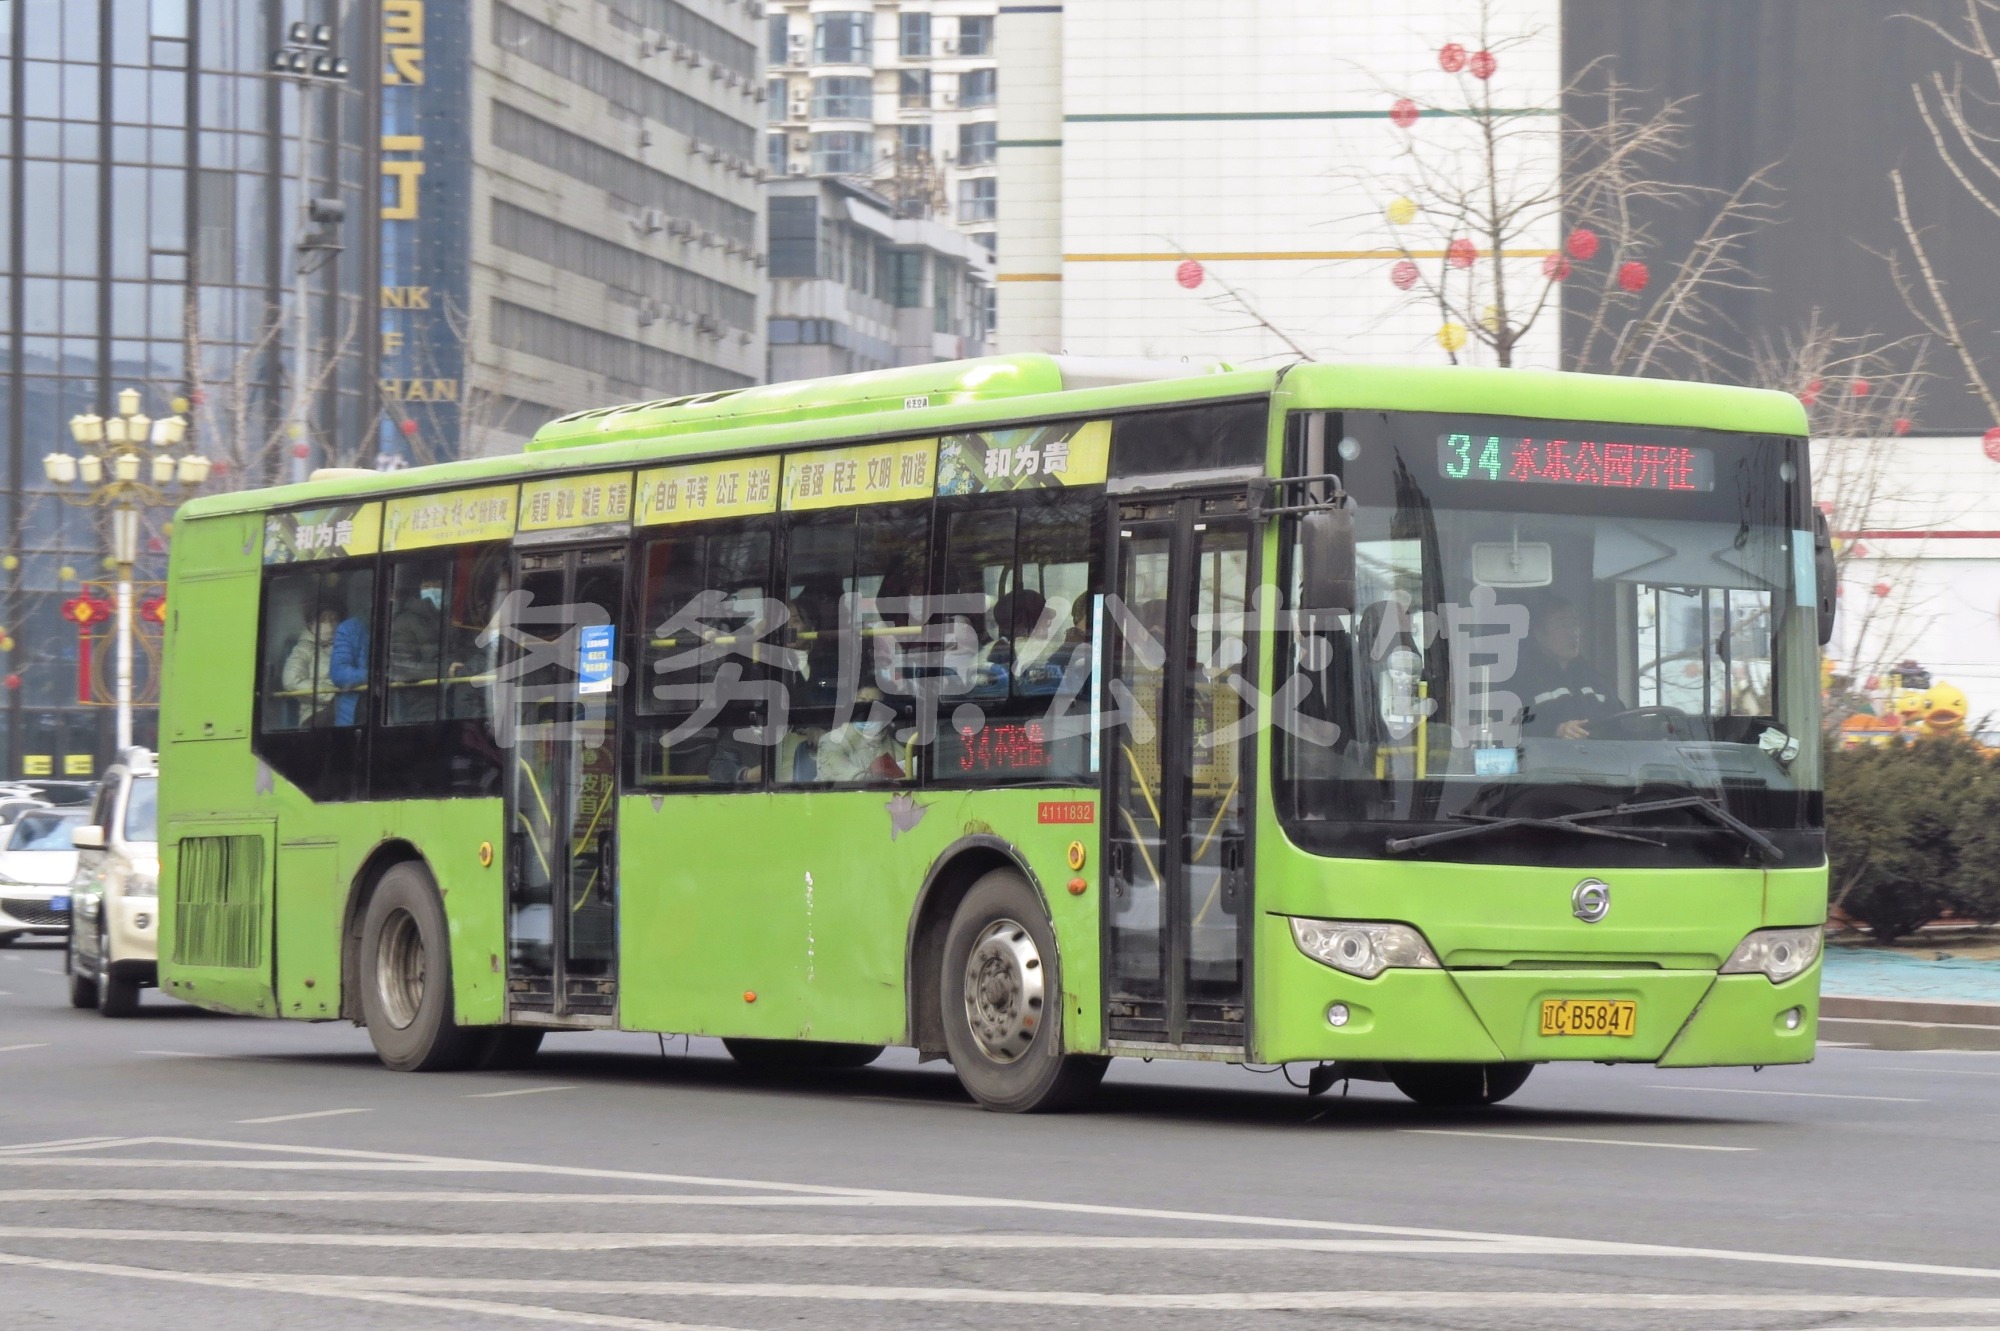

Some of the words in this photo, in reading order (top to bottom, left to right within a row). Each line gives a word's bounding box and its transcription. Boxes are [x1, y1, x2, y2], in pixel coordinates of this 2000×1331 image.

[799, 461, 824, 497] 富强
[832, 460, 858, 494] 民主
[865, 456, 891, 490] 文明
[899, 452, 927, 487] 和谐
[984, 442, 1070, 479] 和为贵
[1446, 434, 1502, 480] 34
[1509, 437, 1696, 490] 永乐公园开往
[531, 491, 550, 523] 爱国
[555, 487, 575, 520] 敬业
[581, 485, 601, 518] 诚信
[607, 483, 627, 515] 友善
[655, 479, 677, 512] 自由
[685, 476, 709, 509] 平等
[716, 473, 739, 505] 公正
[746, 469, 771, 502] 法治
[295, 520, 352, 550] 和为贵
[1041, 804, 1091, 820] 4111832
